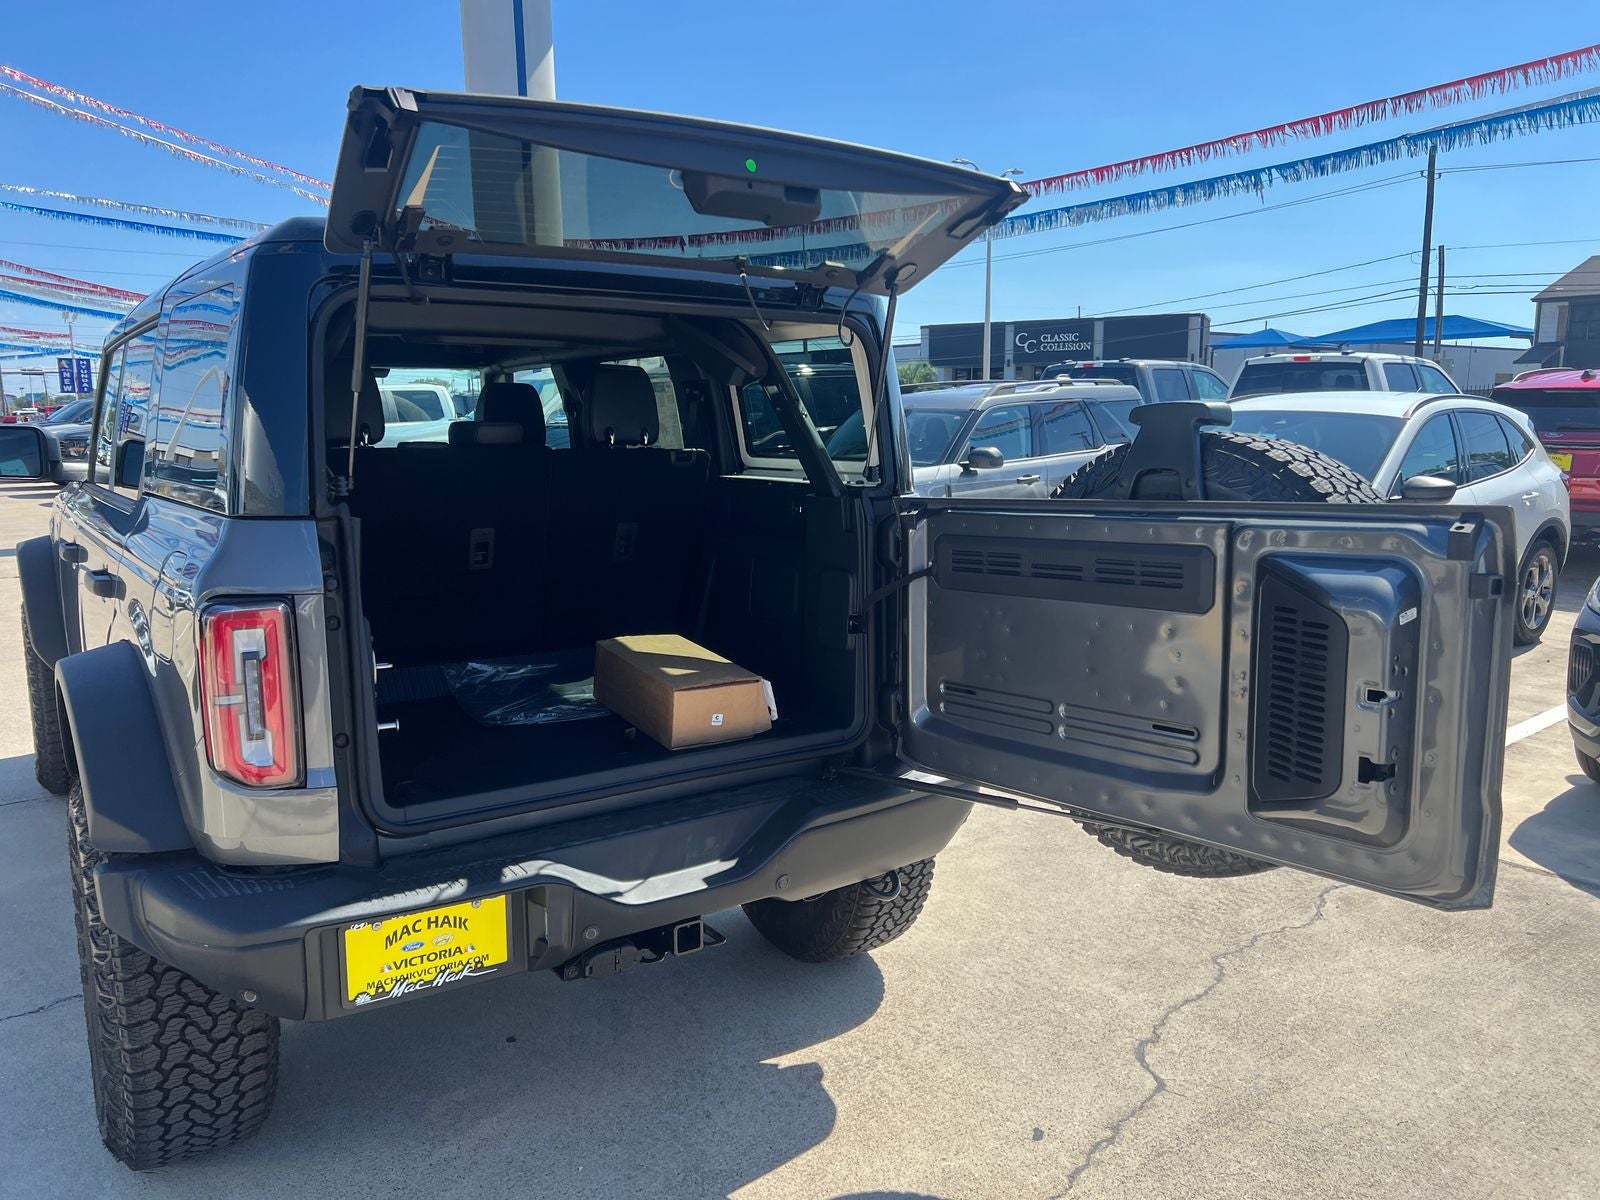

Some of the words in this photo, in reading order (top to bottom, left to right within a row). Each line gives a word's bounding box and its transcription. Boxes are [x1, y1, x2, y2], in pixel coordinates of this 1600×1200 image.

[1040, 333, 1079, 342] CLASSIC
[1040, 342, 1091, 351] COLLISION
[63, 371, 72, 391] NEW
[80, 360, 88, 391] HYUNDAI
[385, 919, 422, 950] MAC
[427, 915, 470, 931] HAIK
[392, 946, 464, 971] VICTORIA
[388, 979, 431, 998] Mac
[432, 963, 480, 987] Haik
